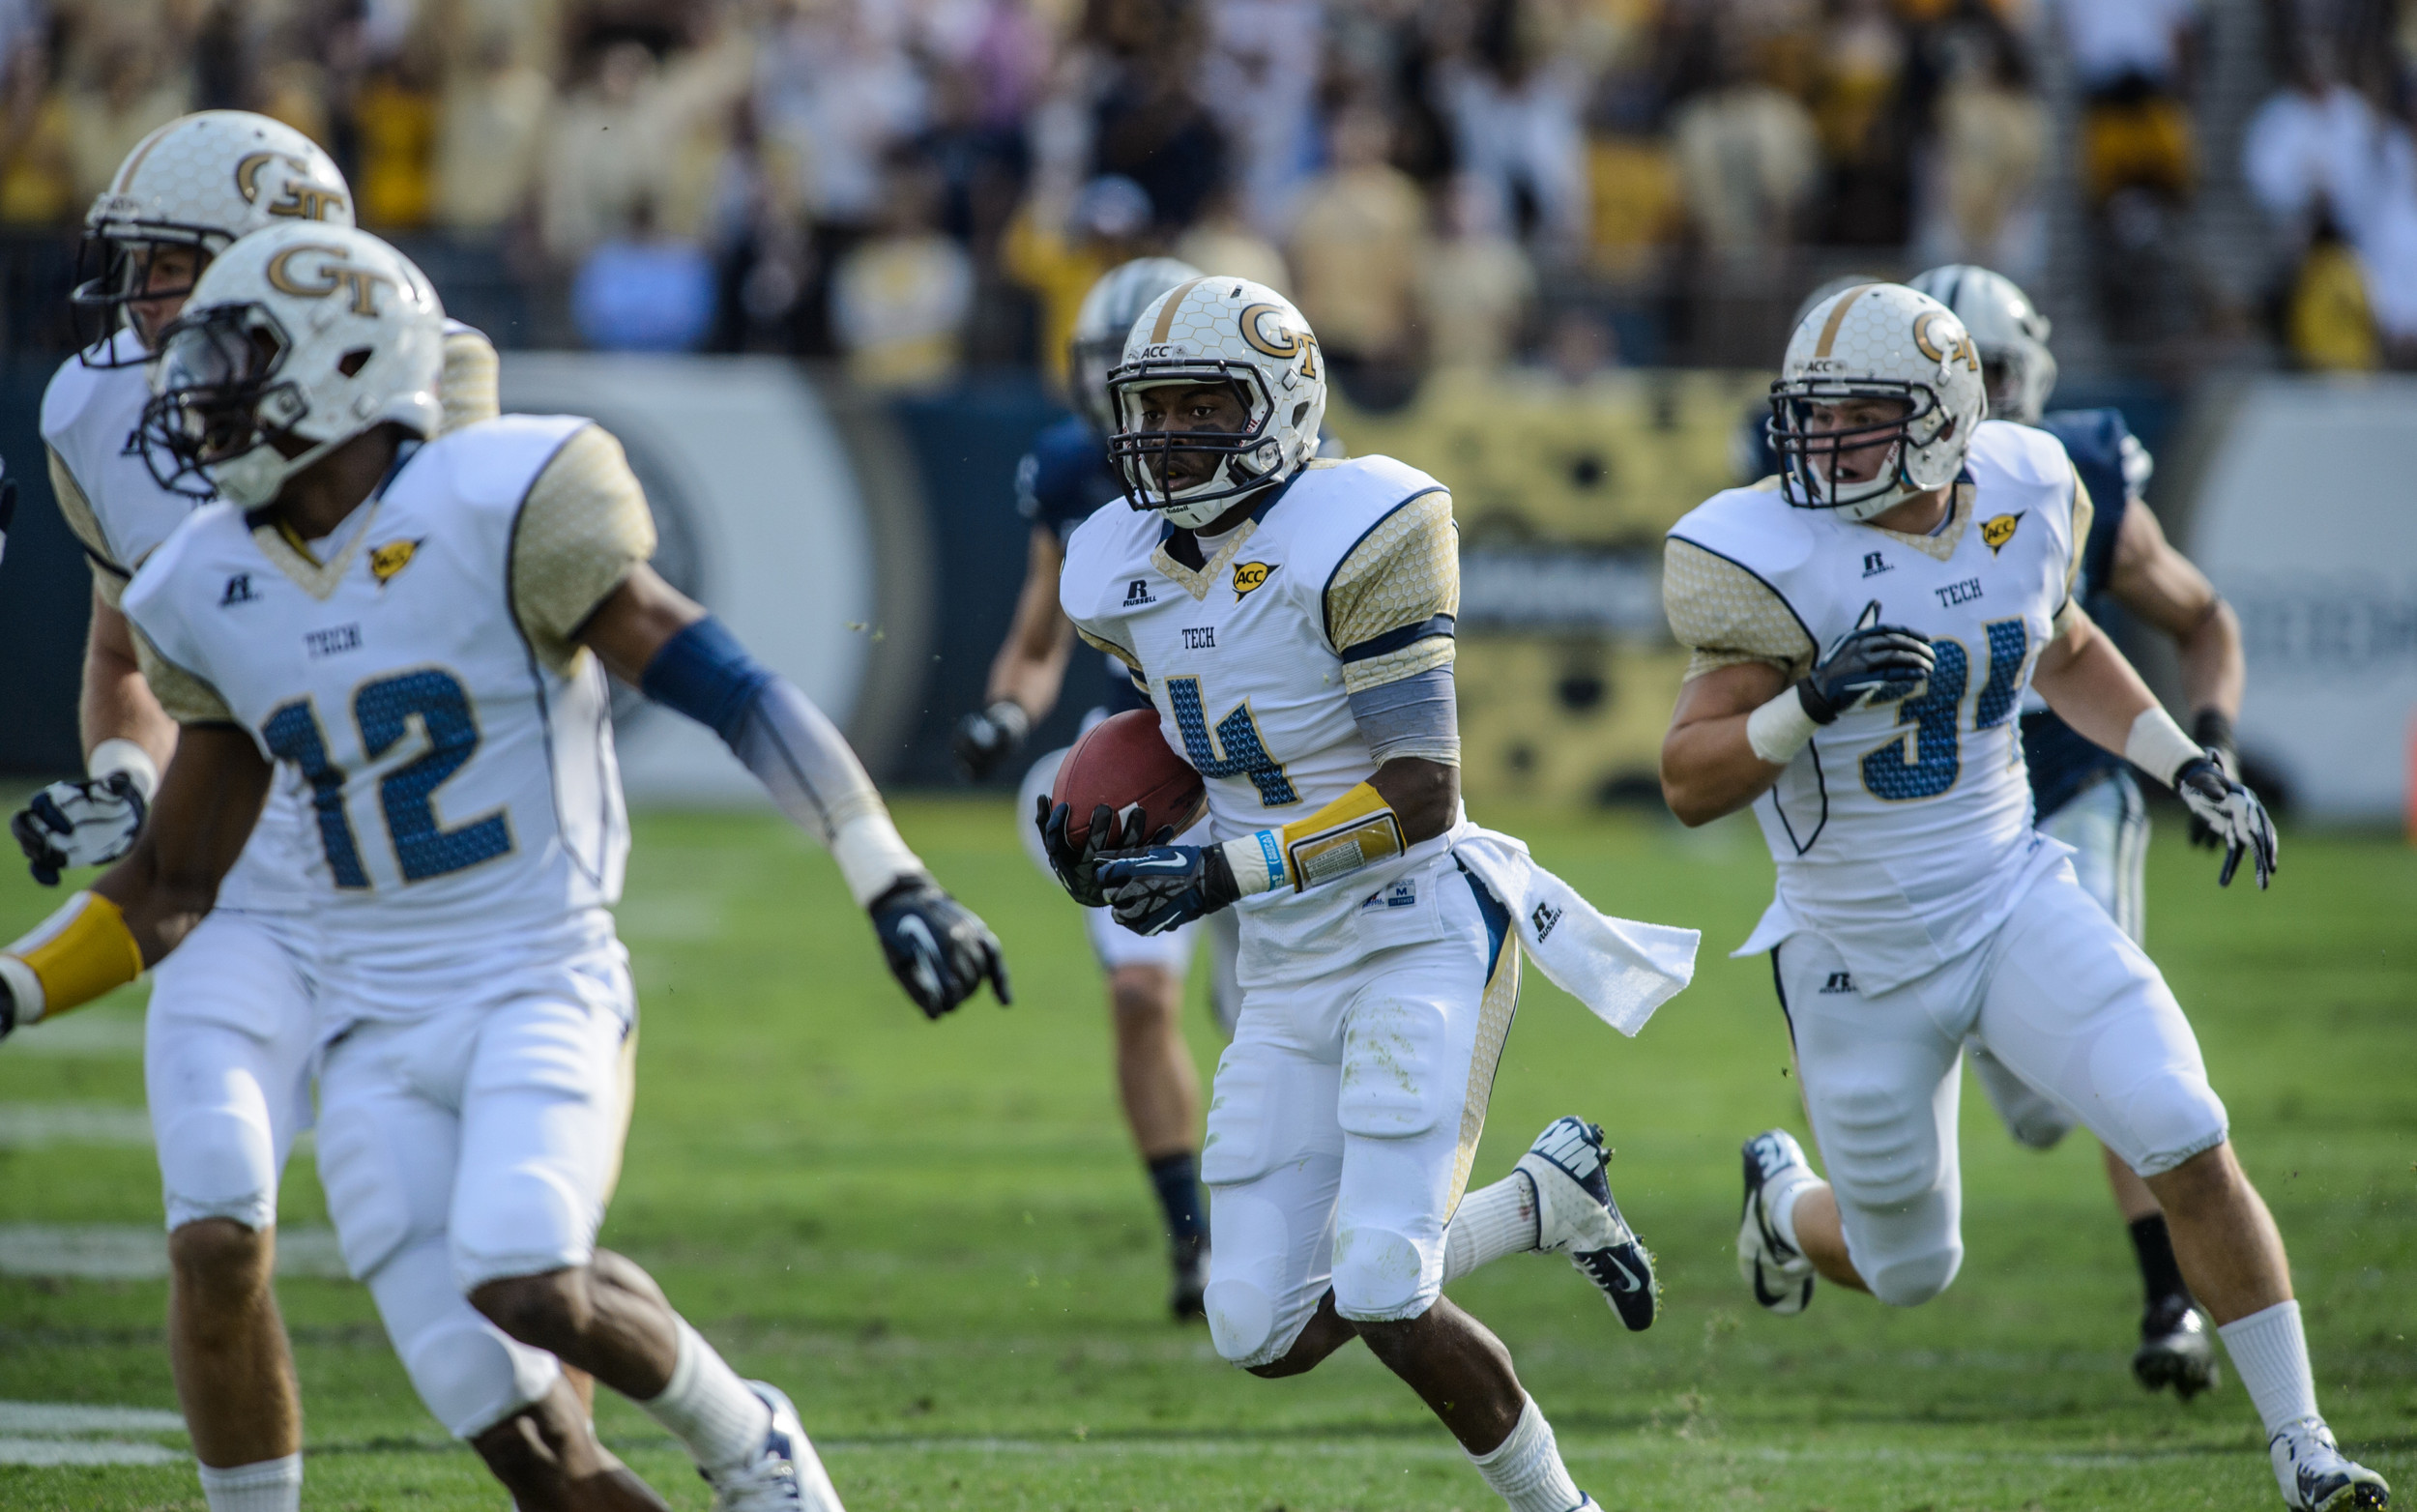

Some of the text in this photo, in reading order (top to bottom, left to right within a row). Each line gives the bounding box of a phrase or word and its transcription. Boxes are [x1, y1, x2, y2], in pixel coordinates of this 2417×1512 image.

[267, 245, 395, 318] GT
[1141, 346, 1171, 359] ACC
[1238, 303, 1319, 380] GT
[1806, 362, 1833, 372] ACC
[1987, 520, 2013, 540] ACC
[1236, 570, 1264, 585] ACC
[1127, 580, 1148, 598] R
[1937, 578, 1983, 608] TECH
[1123, 596, 1156, 607] RUSSELL
[1182, 627, 1215, 649] TECH
[1164, 674, 1303, 809] 4
[260, 661, 519, 892] 12
[1396, 887, 1408, 896] M
[1532, 902, 1554, 932] R
[1537, 909, 1562, 944] RUSSELL
